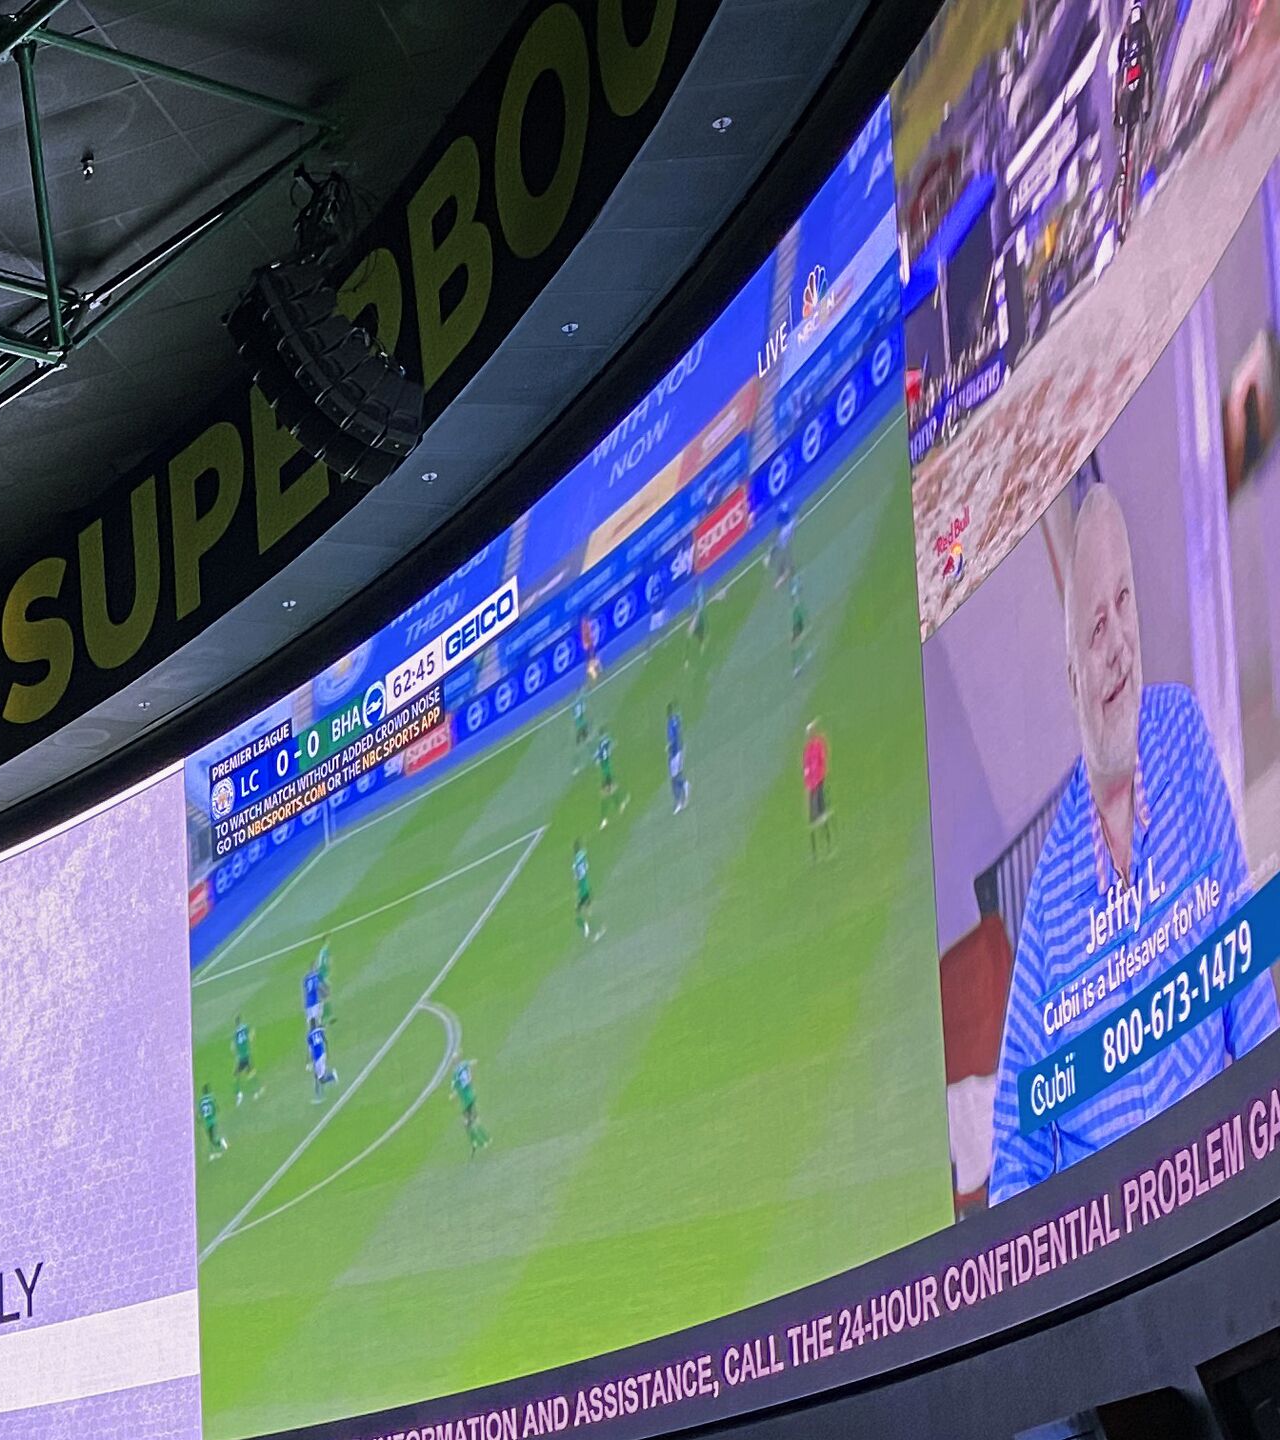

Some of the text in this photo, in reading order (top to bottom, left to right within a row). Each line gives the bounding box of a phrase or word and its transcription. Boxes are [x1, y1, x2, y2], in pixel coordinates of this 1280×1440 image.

[757, 320, 787, 378] LIVE
[609, 412, 670, 487] NOW
[445, 588, 513, 661] GEICO
[212, 724, 290, 781] PREMIER LEAGUE
[216, 824, 228, 839] TO
[230, 804, 262, 830] WATCH
[263, 785, 296, 812] MATCH
[297, 754, 340, 792] WITHOUT
[342, 734, 373, 765] ADDED
[375, 711, 409, 746] CROWD
[411, 687, 440, 719] NOISE
[216, 707, 440, 855] GO TO NBCSPORTS.COM OR THE NBC SPORTS APP
[241, 652, 435, 797] LC 0 0 BHA 62:45
[1043, 877, 1219, 1035] Cubii is a Lifesaver for Me
[1086, 857, 1166, 954] Jeffry L.
[1103, 919, 1252, 1074] 800-673-1479
[522, 1397, 568, 1439] AND
[574, 1355, 719, 1427] ASSISTANCE,
[724, 1334, 784, 1384] CALL
[787, 1314, 834, 1367] THE
[839, 1275, 939, 1350] 24-HOUR
[943, 1194, 1120, 1311] CONFIDENTIAL
[1124, 1116, 1245, 1233] PROBLEM
